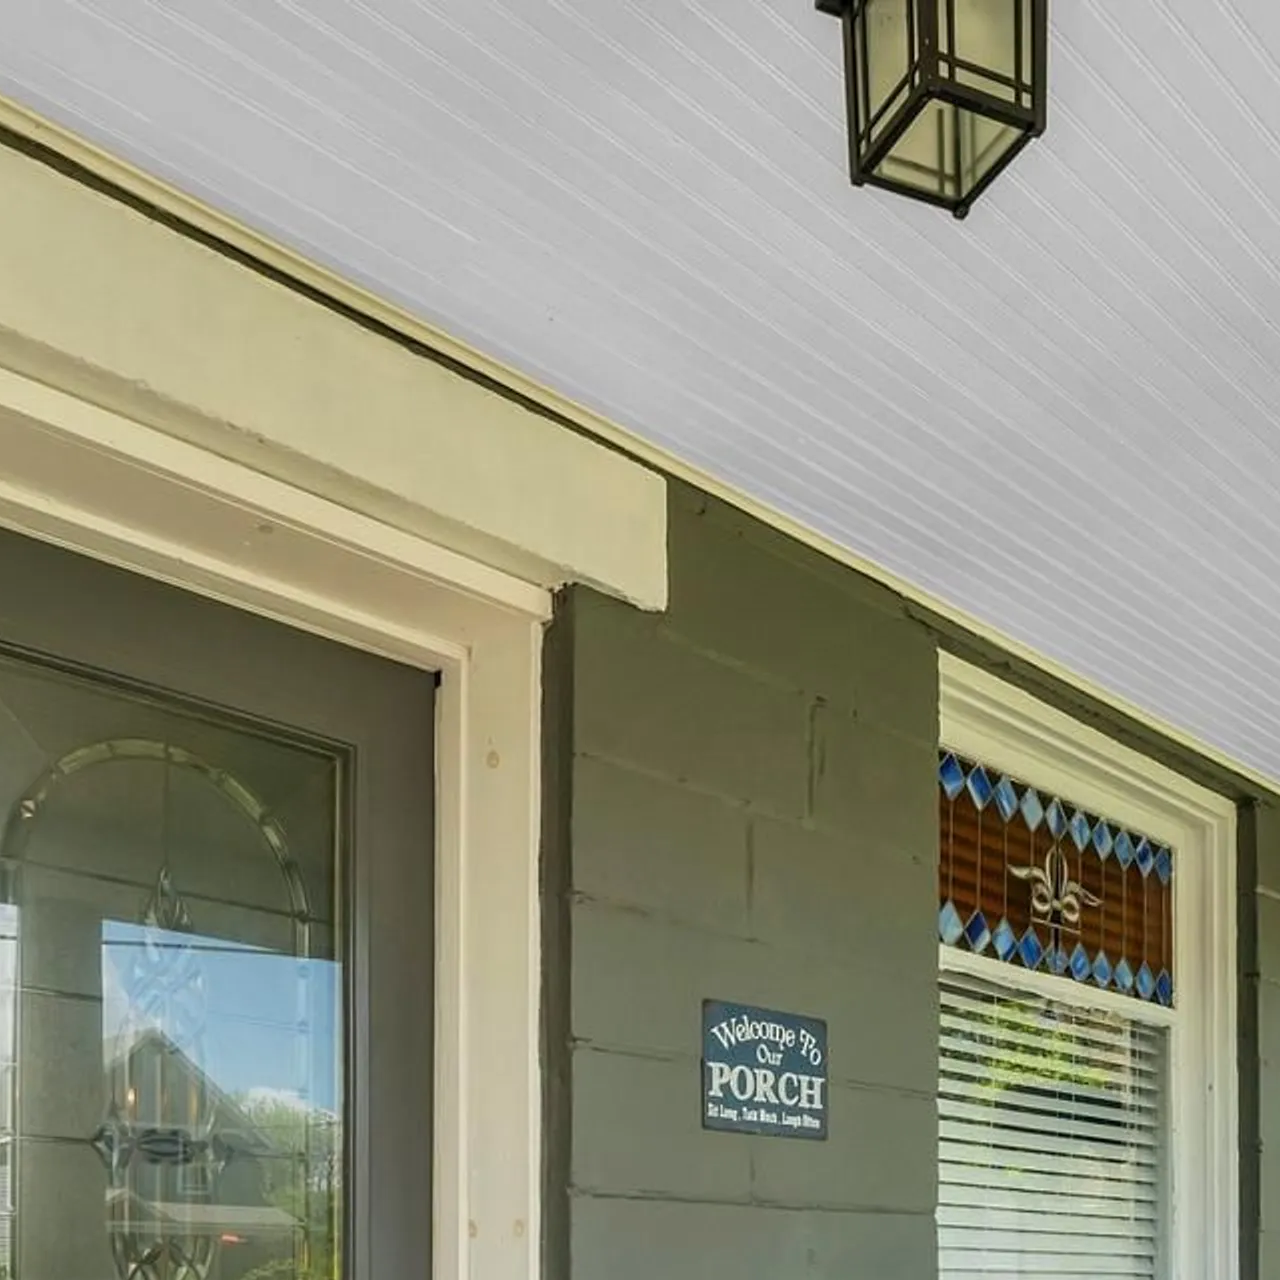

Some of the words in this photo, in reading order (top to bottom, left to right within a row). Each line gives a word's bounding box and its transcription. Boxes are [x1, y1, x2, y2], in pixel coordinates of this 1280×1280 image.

[710, 1014, 795, 1050] Welcome
[799, 1028, 821, 1065] To
[756, 1043, 783, 1066] Our
[706, 1061, 825, 1109] PORCH
